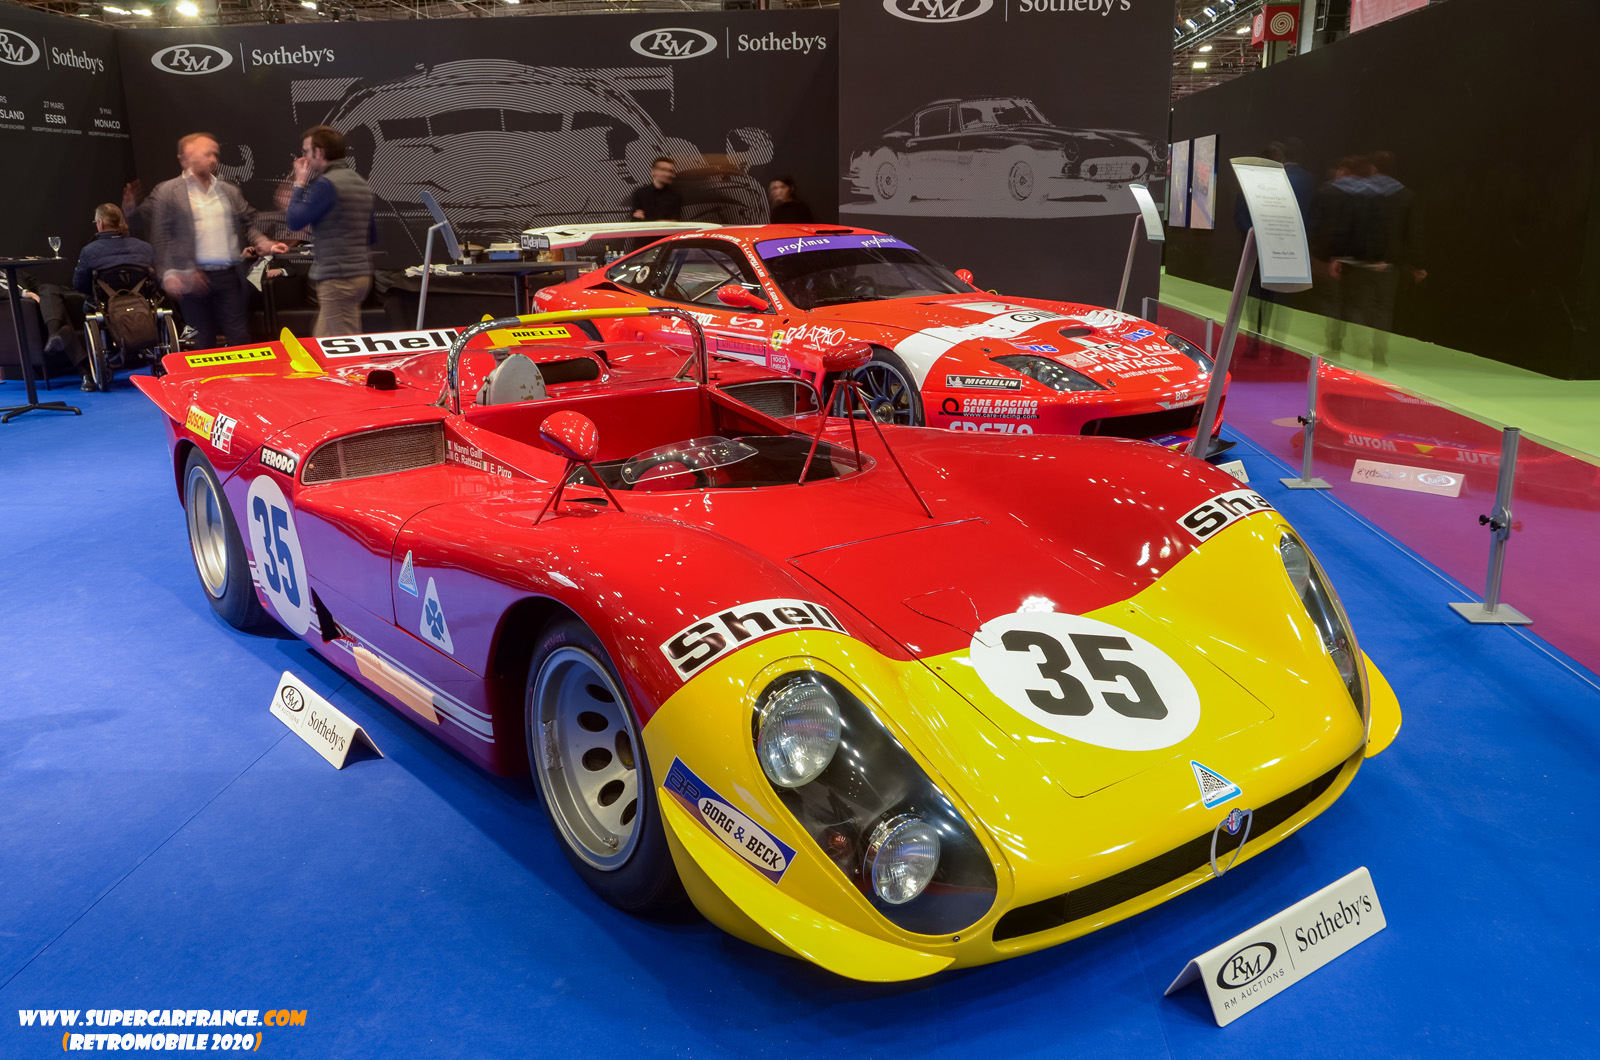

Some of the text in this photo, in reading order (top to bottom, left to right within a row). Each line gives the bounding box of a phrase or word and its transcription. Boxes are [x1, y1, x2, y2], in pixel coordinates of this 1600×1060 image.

[737, 31, 827, 55] Sotheby's
[51, 46, 105, 75] Sotheby's
[251, 45, 335, 67] Sotheby's
[0, 108, 25, 120] SLAND
[49, 101, 65, 110] MARS
[44, 113, 67, 124] ESSEN
[93, 118, 121, 129] MONACO
[776, 237, 831, 254] proximus
[511, 329, 567, 338] ARELLO
[189, 350, 273, 364] CARELLO
[1101, 356, 1174, 373] INTAGLI
[964, 377, 1018, 387] MICHELIN
[963, 398, 1038, 408] CARE RACING
[963, 406, 1038, 415] DEVELOPMENT
[187, 409, 206, 433] BOSCH
[963, 412, 1038, 420] www.care-racing.com
[453, 442, 483, 460] Nanni Galli
[261, 447, 296, 474] FERODO
[454, 452, 482, 470] G. Rattazzi
[489, 462, 497, 474] E.
[252, 495, 302, 609] 35
[667, 602, 847, 674] Shell
[1000, 629, 1169, 721] 35
[307, 710, 346, 753] Sotheby's
[702, 800, 783, 870] BORG & BECK
[1294, 894, 1373, 953] Sotheby's
[1223, 968, 1286, 1011] RM AUCTIONS
